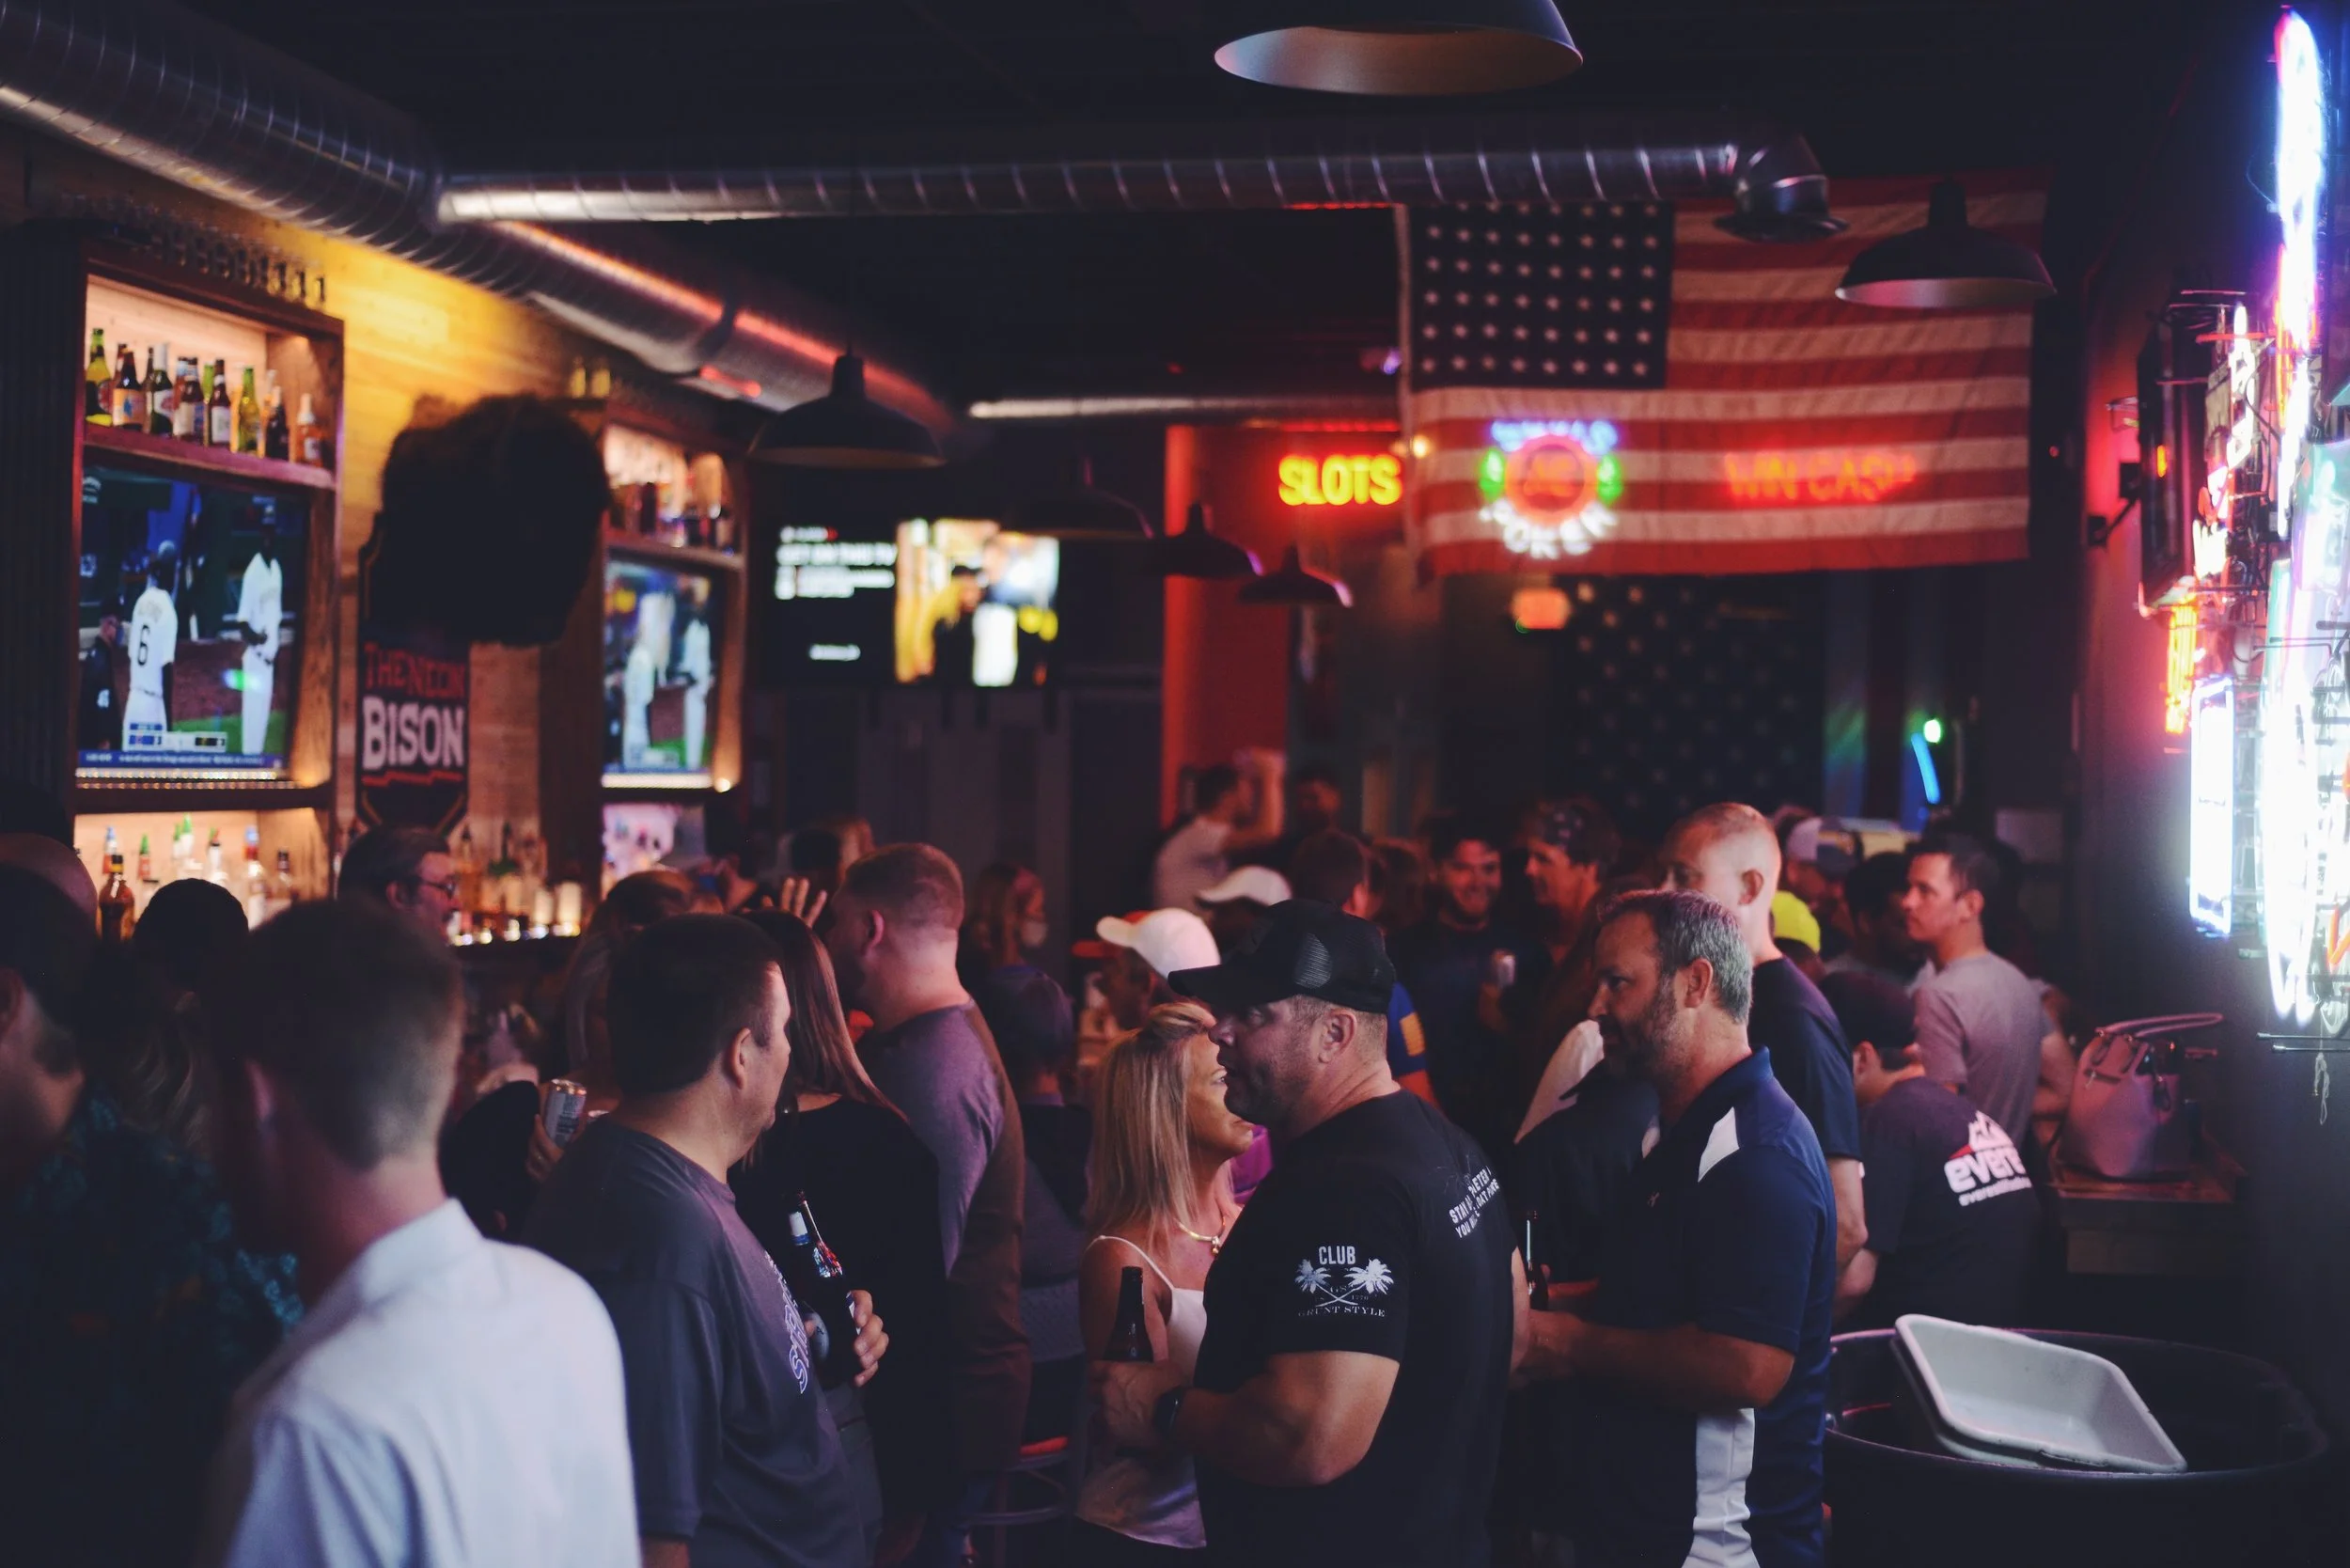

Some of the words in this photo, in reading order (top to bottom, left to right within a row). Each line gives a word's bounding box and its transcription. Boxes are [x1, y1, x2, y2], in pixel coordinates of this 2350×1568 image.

[1278, 454, 1402, 506] SLOTS
[137, 624, 150, 666] 6
[363, 696, 465, 770] BISON
[1449, 1200, 1469, 1224] STAY
[1455, 1221, 1472, 1238] YOU
[1318, 1246, 1355, 1265] CLUB
[1344, 1307, 1386, 1317] STYLE
